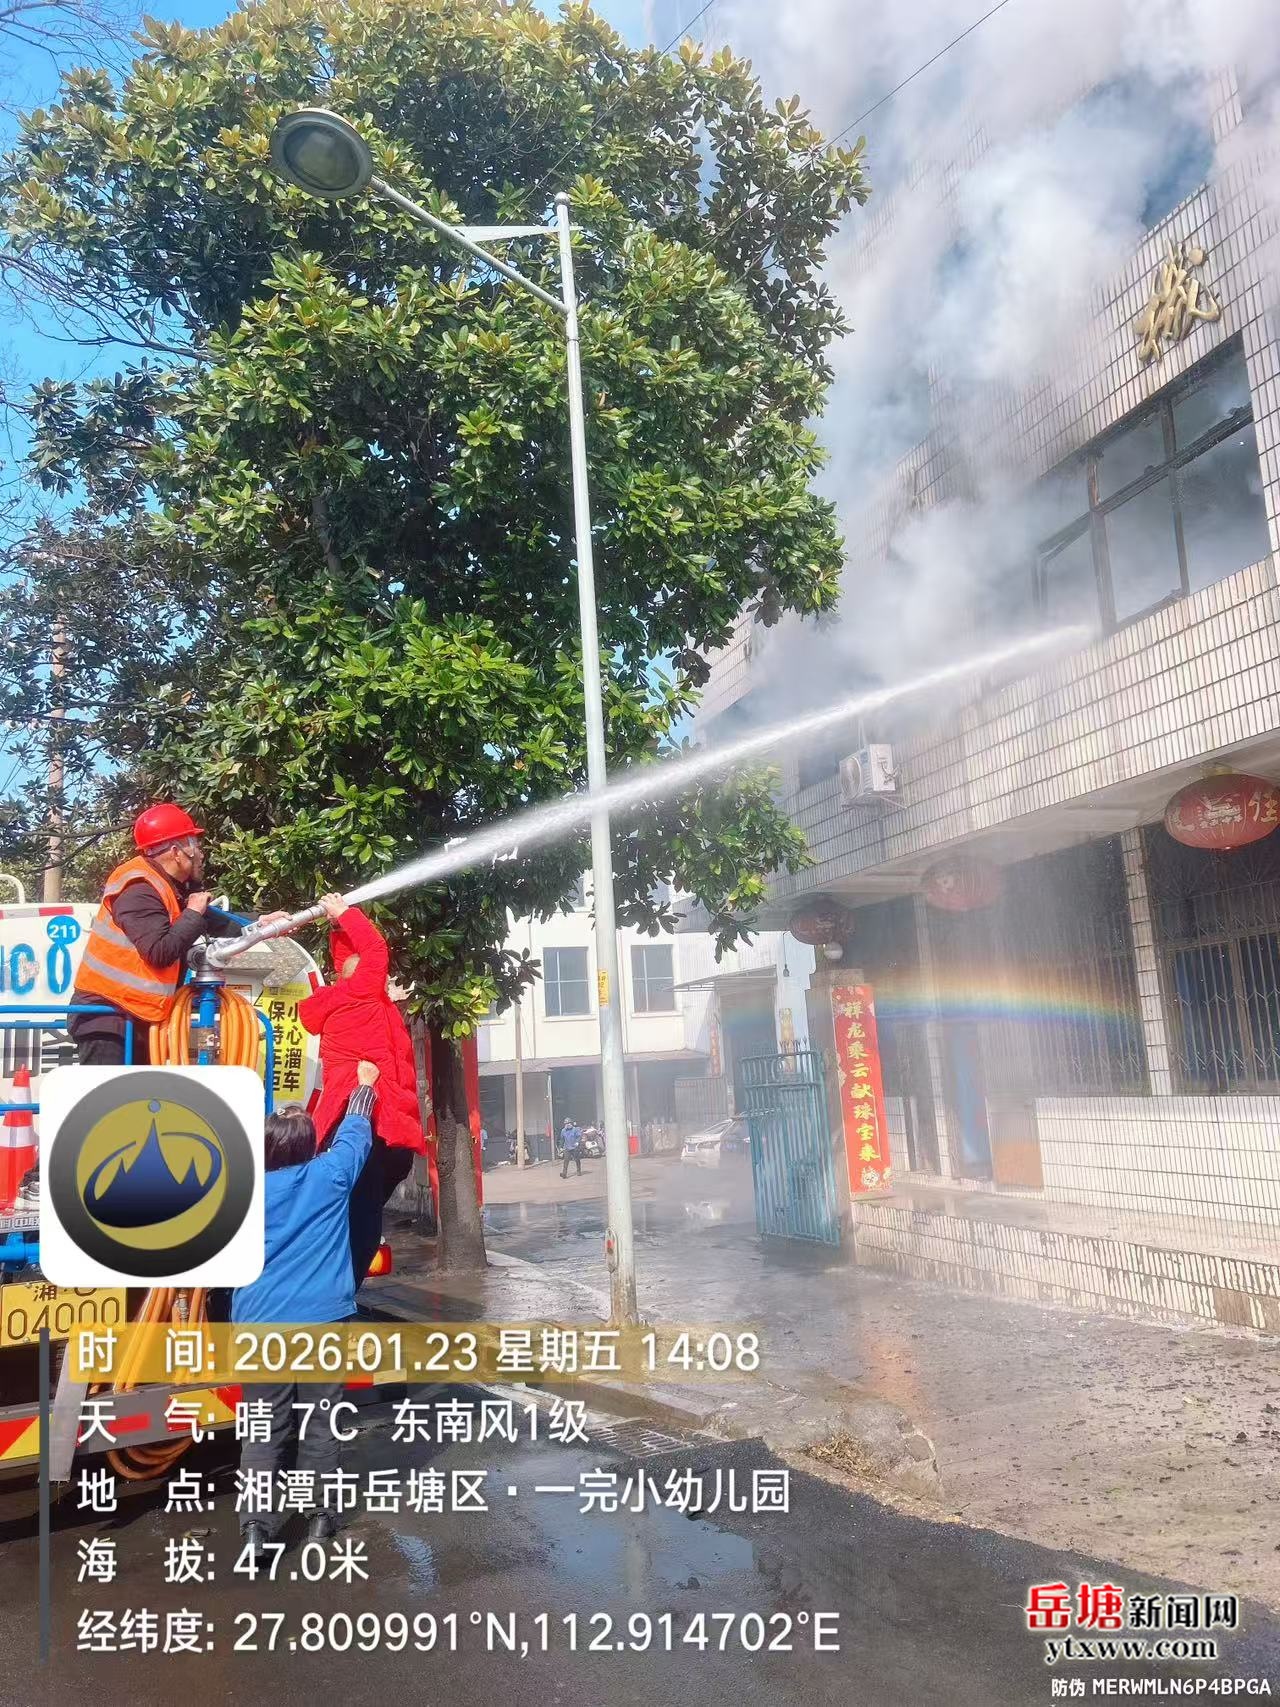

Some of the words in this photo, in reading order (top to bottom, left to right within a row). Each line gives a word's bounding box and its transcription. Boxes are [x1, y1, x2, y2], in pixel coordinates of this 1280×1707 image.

[49, 924, 77, 939] 211
[282, 1002, 302, 1092] 小心溜车
[8, 1297, 120, 1340] 04000
